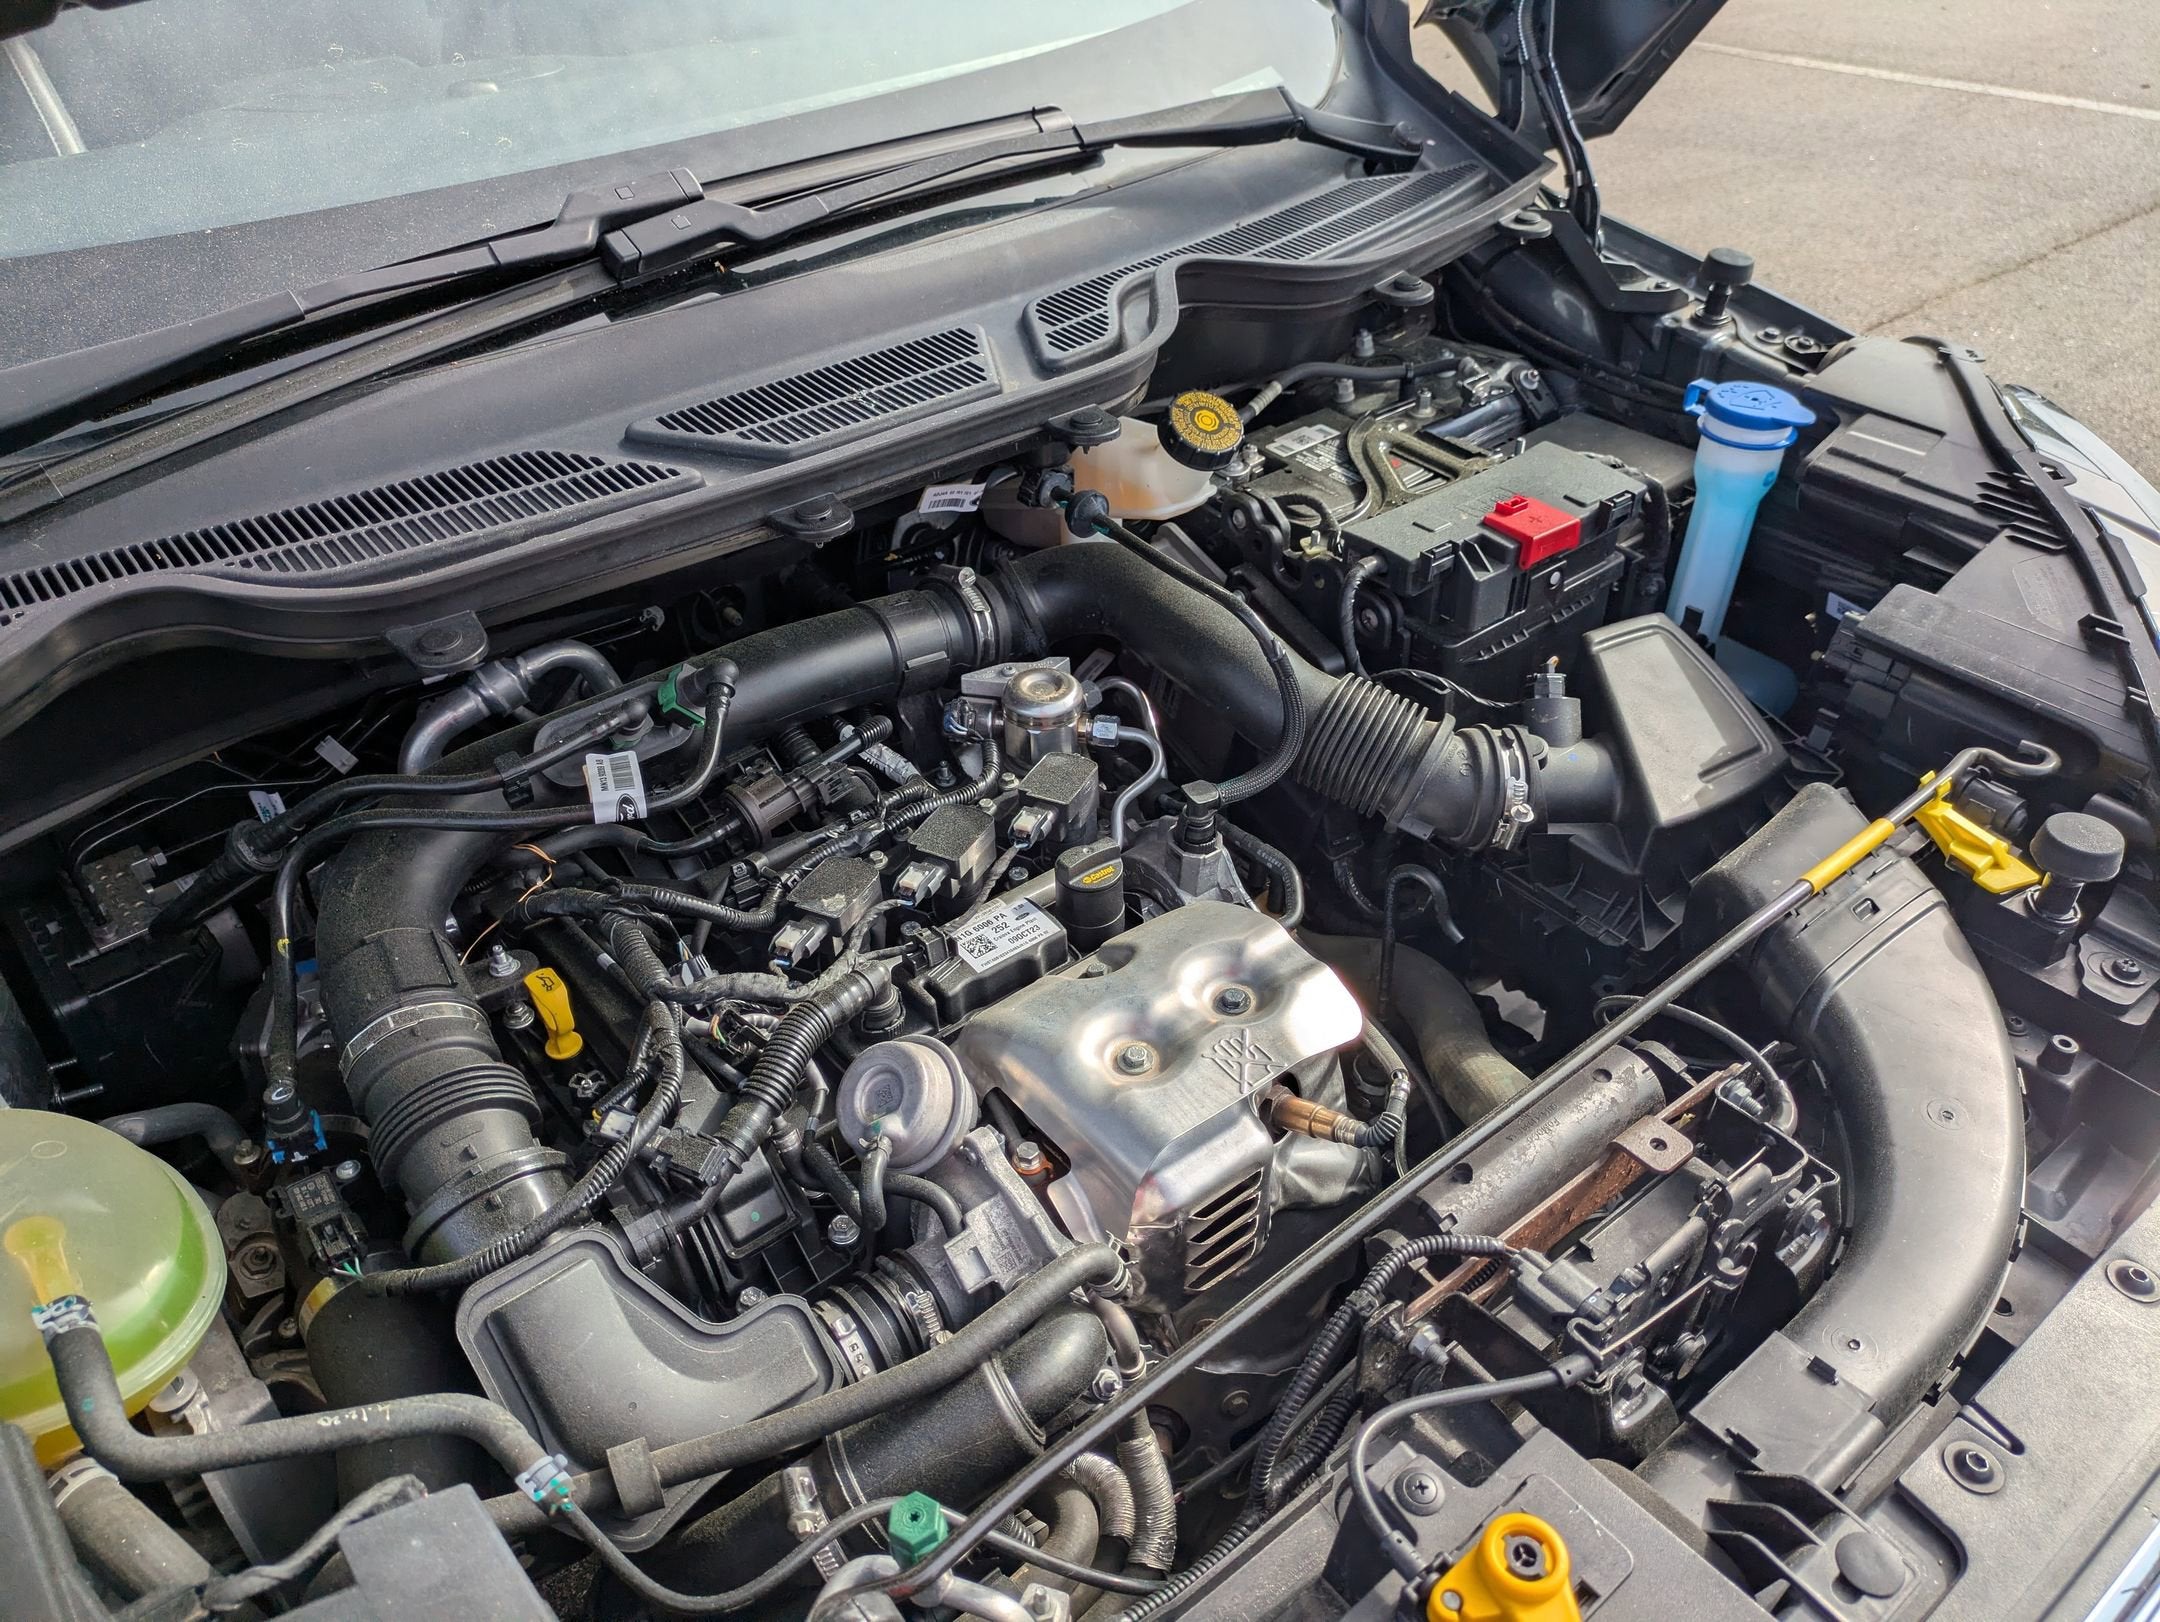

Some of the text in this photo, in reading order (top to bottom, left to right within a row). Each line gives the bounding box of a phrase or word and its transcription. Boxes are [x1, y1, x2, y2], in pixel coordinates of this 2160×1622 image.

[1089, 865, 1115, 881] Castrol
[973, 919, 994, 932] 6006
[993, 912, 1008, 922] PA
[991, 921, 1010, 934] 252
[1009, 922, 1025, 933] Engine
[1024, 917, 1037, 925] Plant
